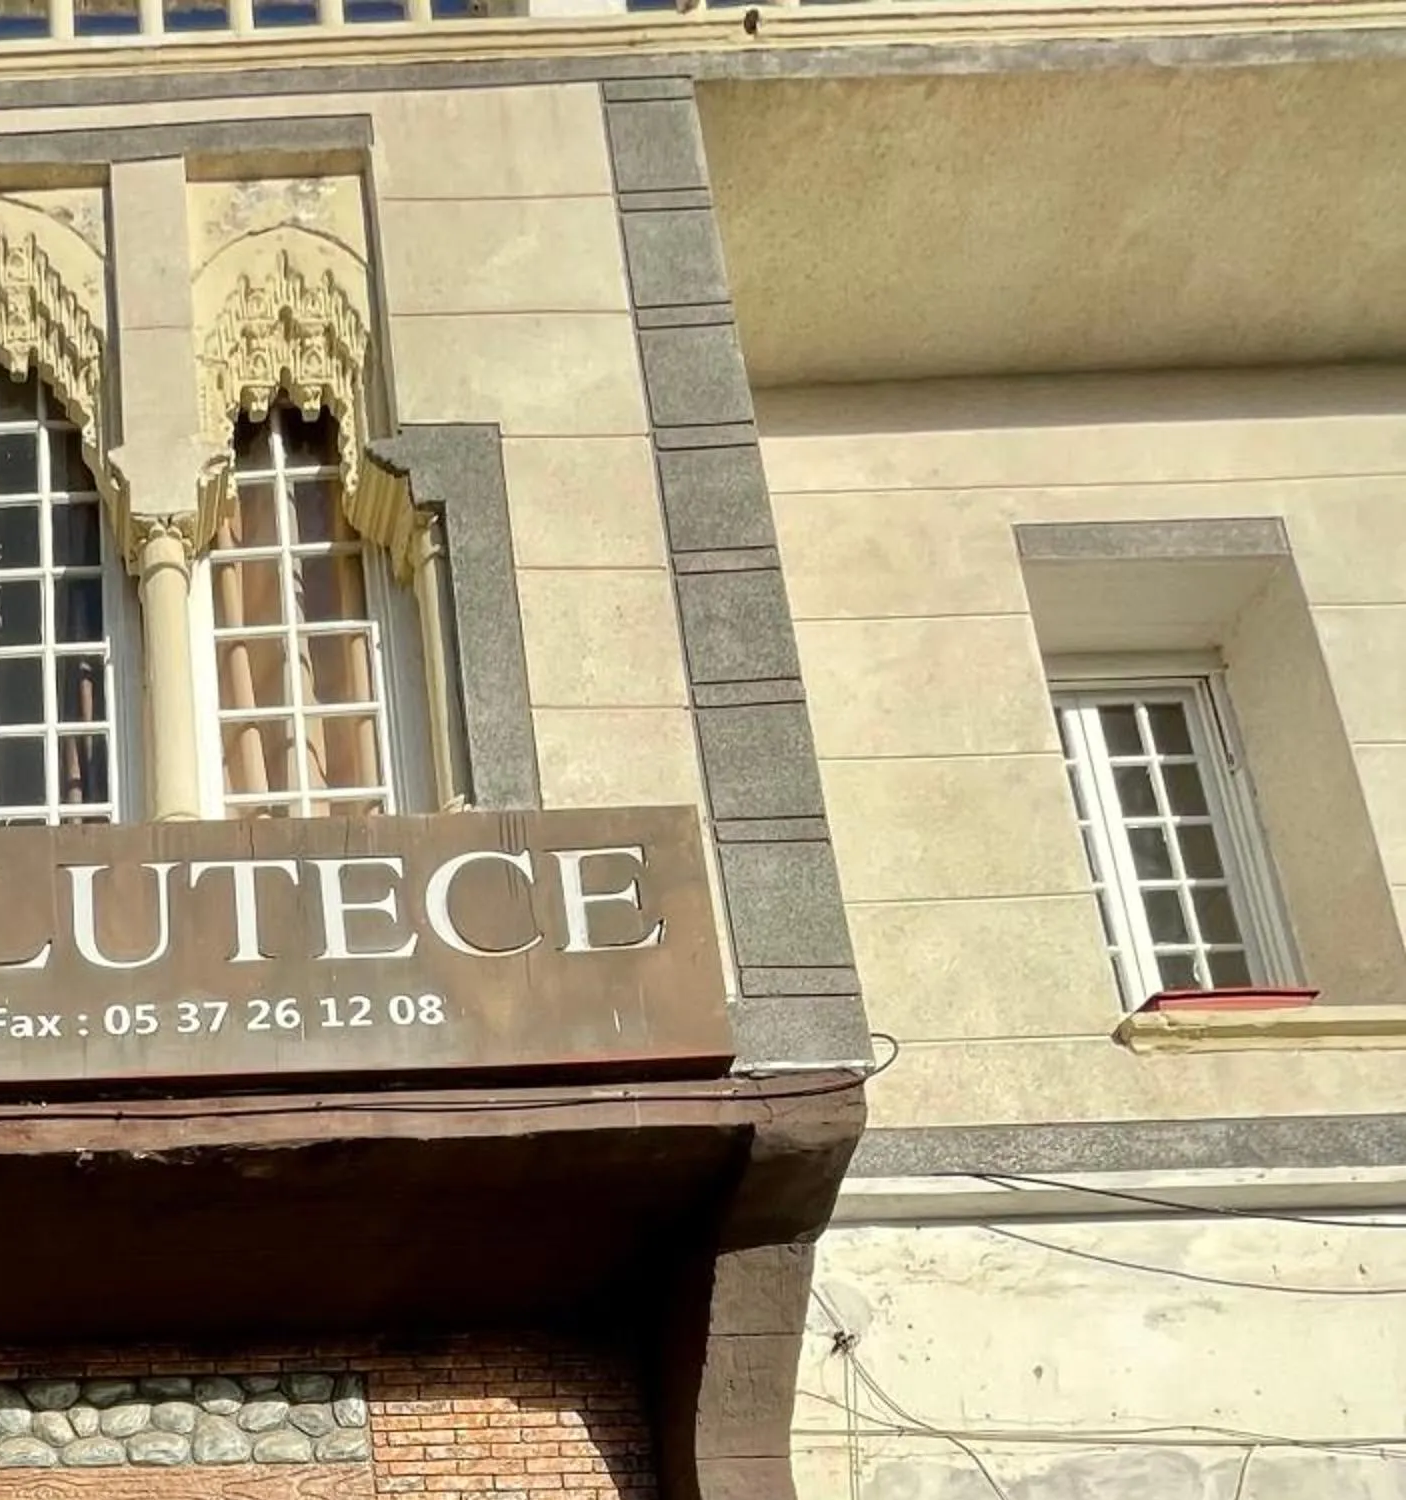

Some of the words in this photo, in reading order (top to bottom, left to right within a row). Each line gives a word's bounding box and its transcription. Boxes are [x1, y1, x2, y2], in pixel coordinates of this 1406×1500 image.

[104, 1003, 159, 1036] 05
[177, 1001, 230, 1034] 37
[247, 998, 302, 1031] 26
[319, 995, 373, 1028] 12
[388, 993, 445, 1026] 08
